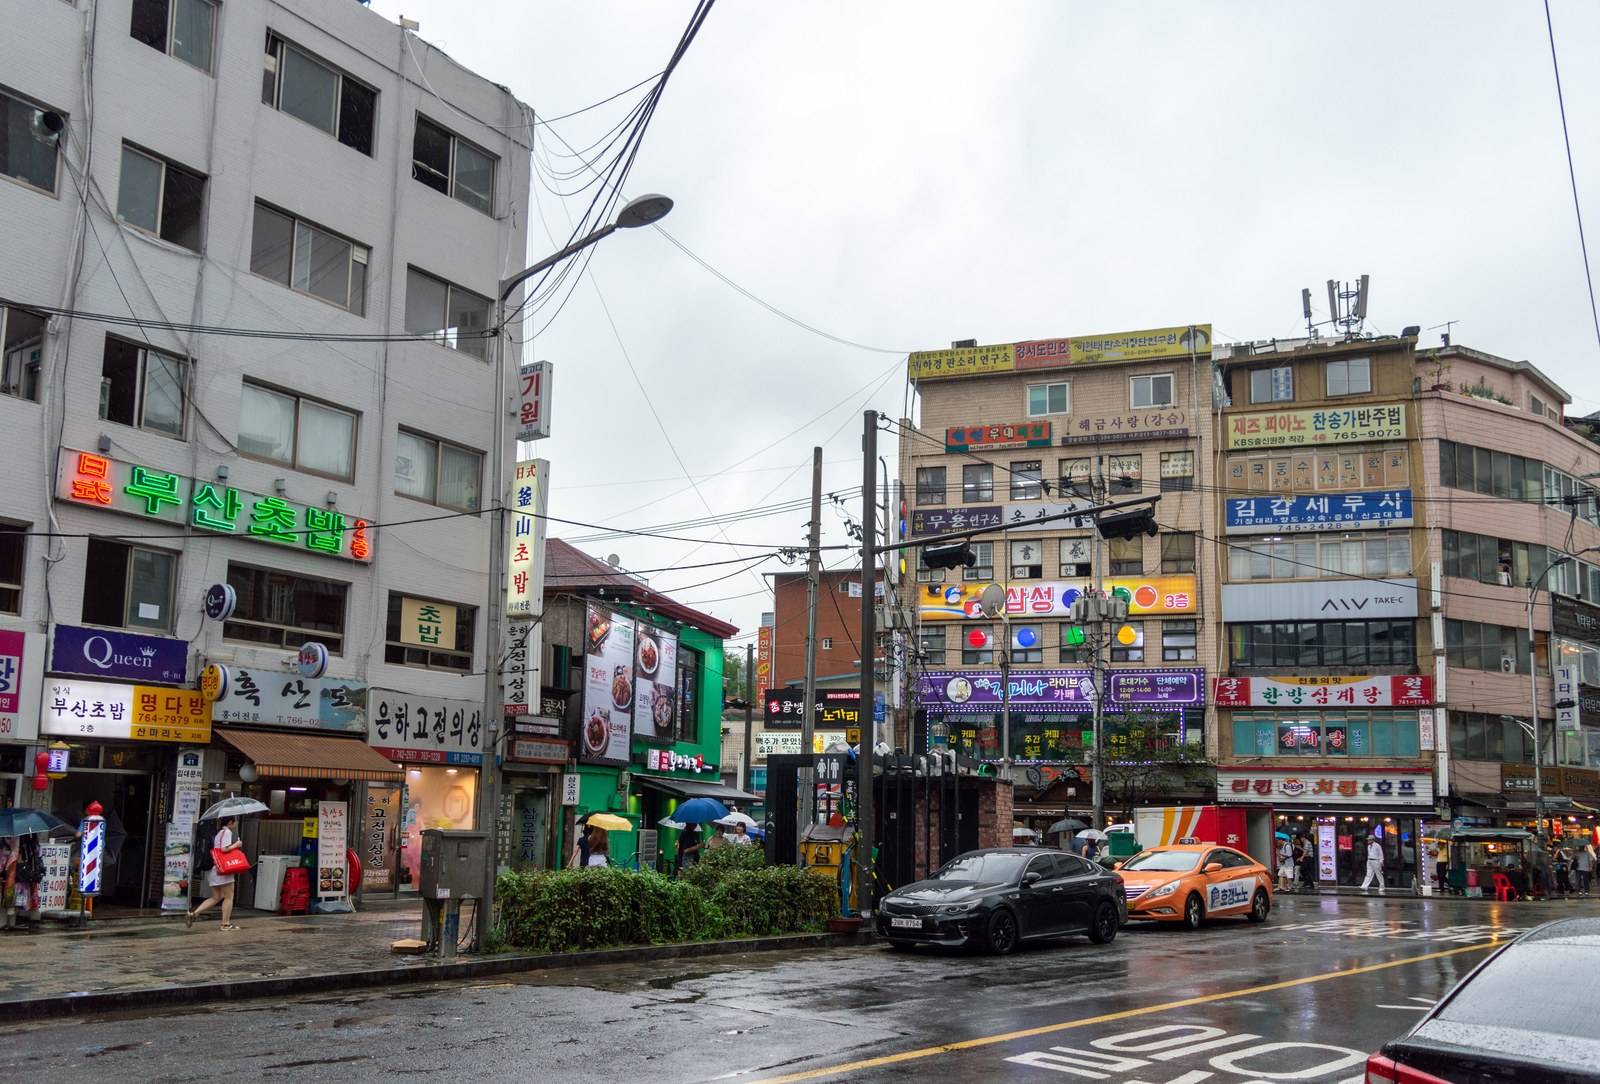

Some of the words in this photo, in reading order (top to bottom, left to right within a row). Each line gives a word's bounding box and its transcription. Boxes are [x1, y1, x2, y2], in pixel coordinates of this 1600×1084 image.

[946, 355, 976, 369] 판소리
[979, 352, 1011, 366] 연구소
[520, 372, 541, 425] 기원
[1264, 415, 1307, 433] 피아노
[1333, 428, 1401, 440] 765-9073
[71, 452, 113, 506] 日式
[515, 464, 537, 480] 日式
[123, 465, 348, 554] 부산초밥
[1165, 593, 1190, 608] 3층
[417, 604, 442, 645] 초밥
[507, 625, 529, 638] 은하
[82, 635, 153, 669] Queen
[507, 639, 528, 703] 고전의상실
[234, 669, 352, 710] 흑산도
[1048, 677, 1079, 689] 라이브
[1218, 678, 1242, 701] 장수
[1400, 676, 1424, 699] 원조
[1053, 689, 1075, 701] 카페
[1262, 685, 1383, 705] 한방삼계탕
[51, 697, 125, 721] 부산초밥
[141, 693, 206, 717] 명다방
[137, 712, 190, 725] 764-7979
[222, 710, 261, 721] 홍어전문
[822, 707, 859, 722] 노가리
[80, 724, 95, 733] 2층
[136, 727, 183, 739] 산마리노
[375, 701, 482, 748] 은하고전의상
[961, 729, 976, 739] 커피
[1024, 735, 1041, 745] 주간
[1280, 729, 1346, 748] 삼계탕
[1312, 778, 1359, 797] 치킨
[1374, 779, 1417, 796] 호프
[369, 807, 387, 868] 고전의상실
[49, 879, 67, 892] 4,000
[48, 895, 65, 908] 5,000
[1220, 886, 1249, 905] 호갱노노
